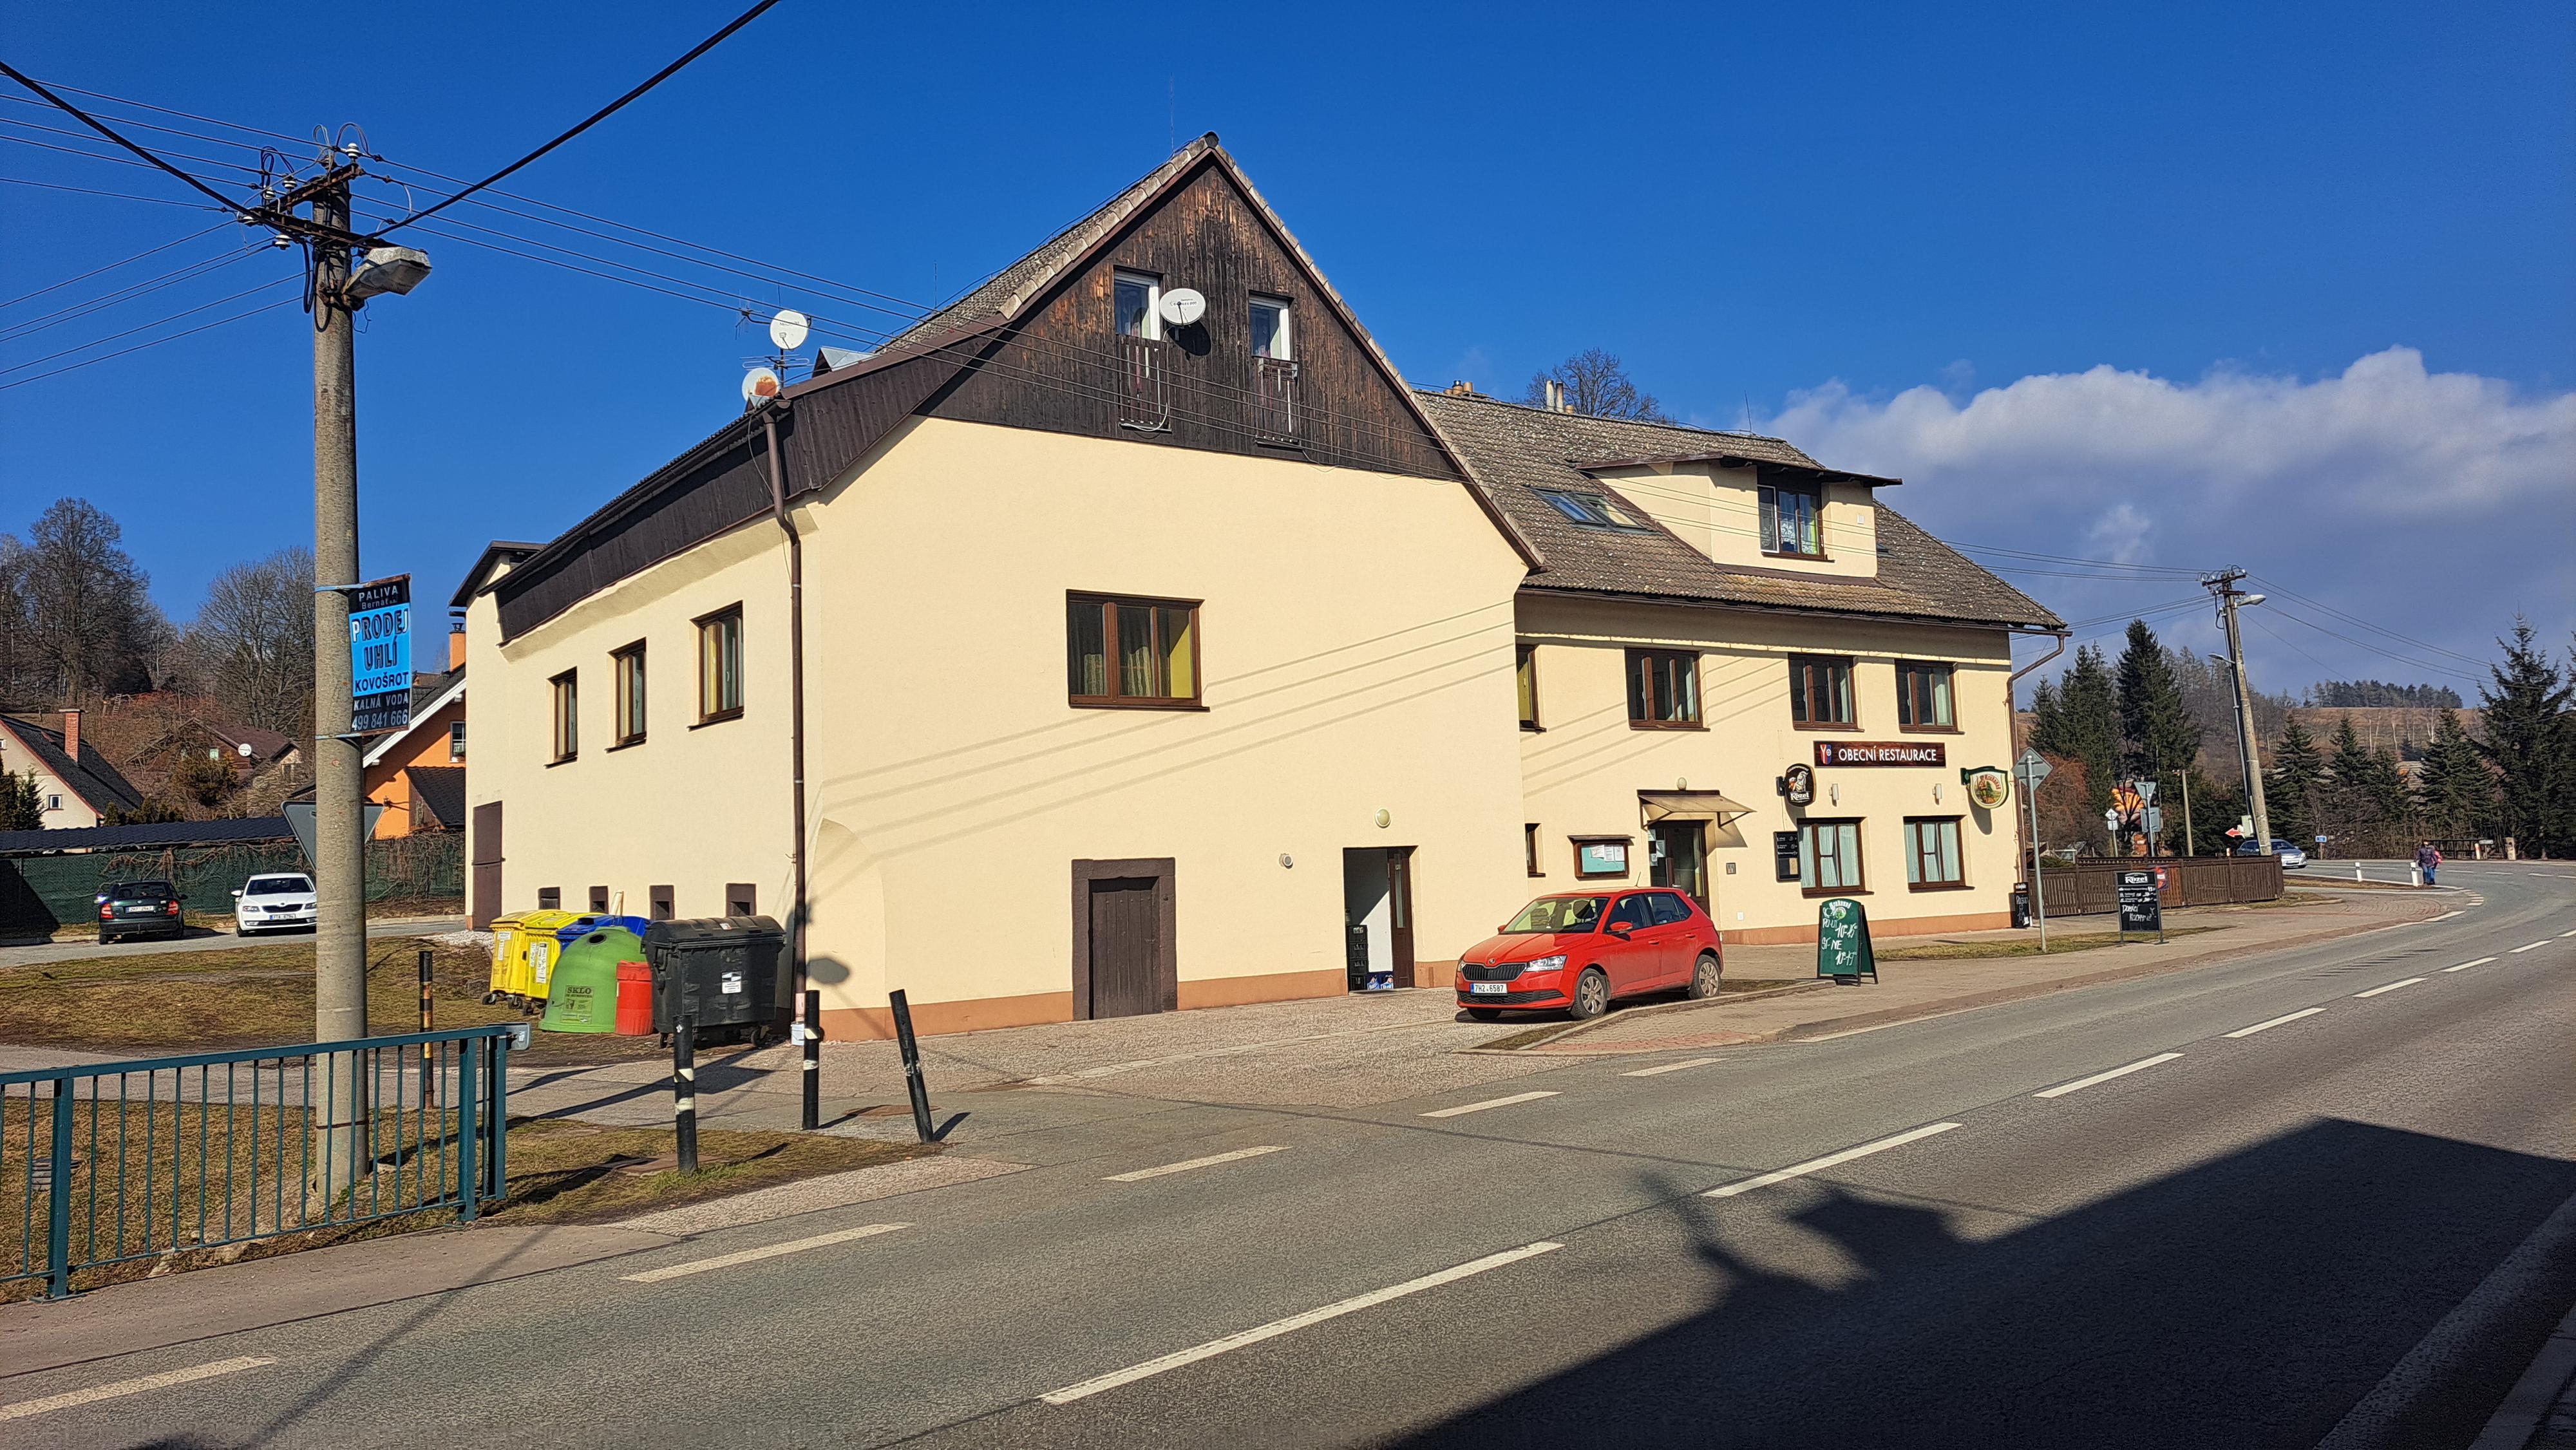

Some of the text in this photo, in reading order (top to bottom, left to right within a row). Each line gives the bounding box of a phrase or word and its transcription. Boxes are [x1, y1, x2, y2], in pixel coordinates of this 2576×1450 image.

[359, 585, 398, 602] PALIVA
[352, 608, 408, 643] PRODEJ
[364, 636, 397, 672] UHLÍ
[355, 672, 409, 693] KOVOŠROT
[354, 692, 409, 711] KALNÁ VODA
[352, 709, 408, 731] 499 841 666
[1839, 745, 1937, 761] OBECNÍ RESTAURACE
